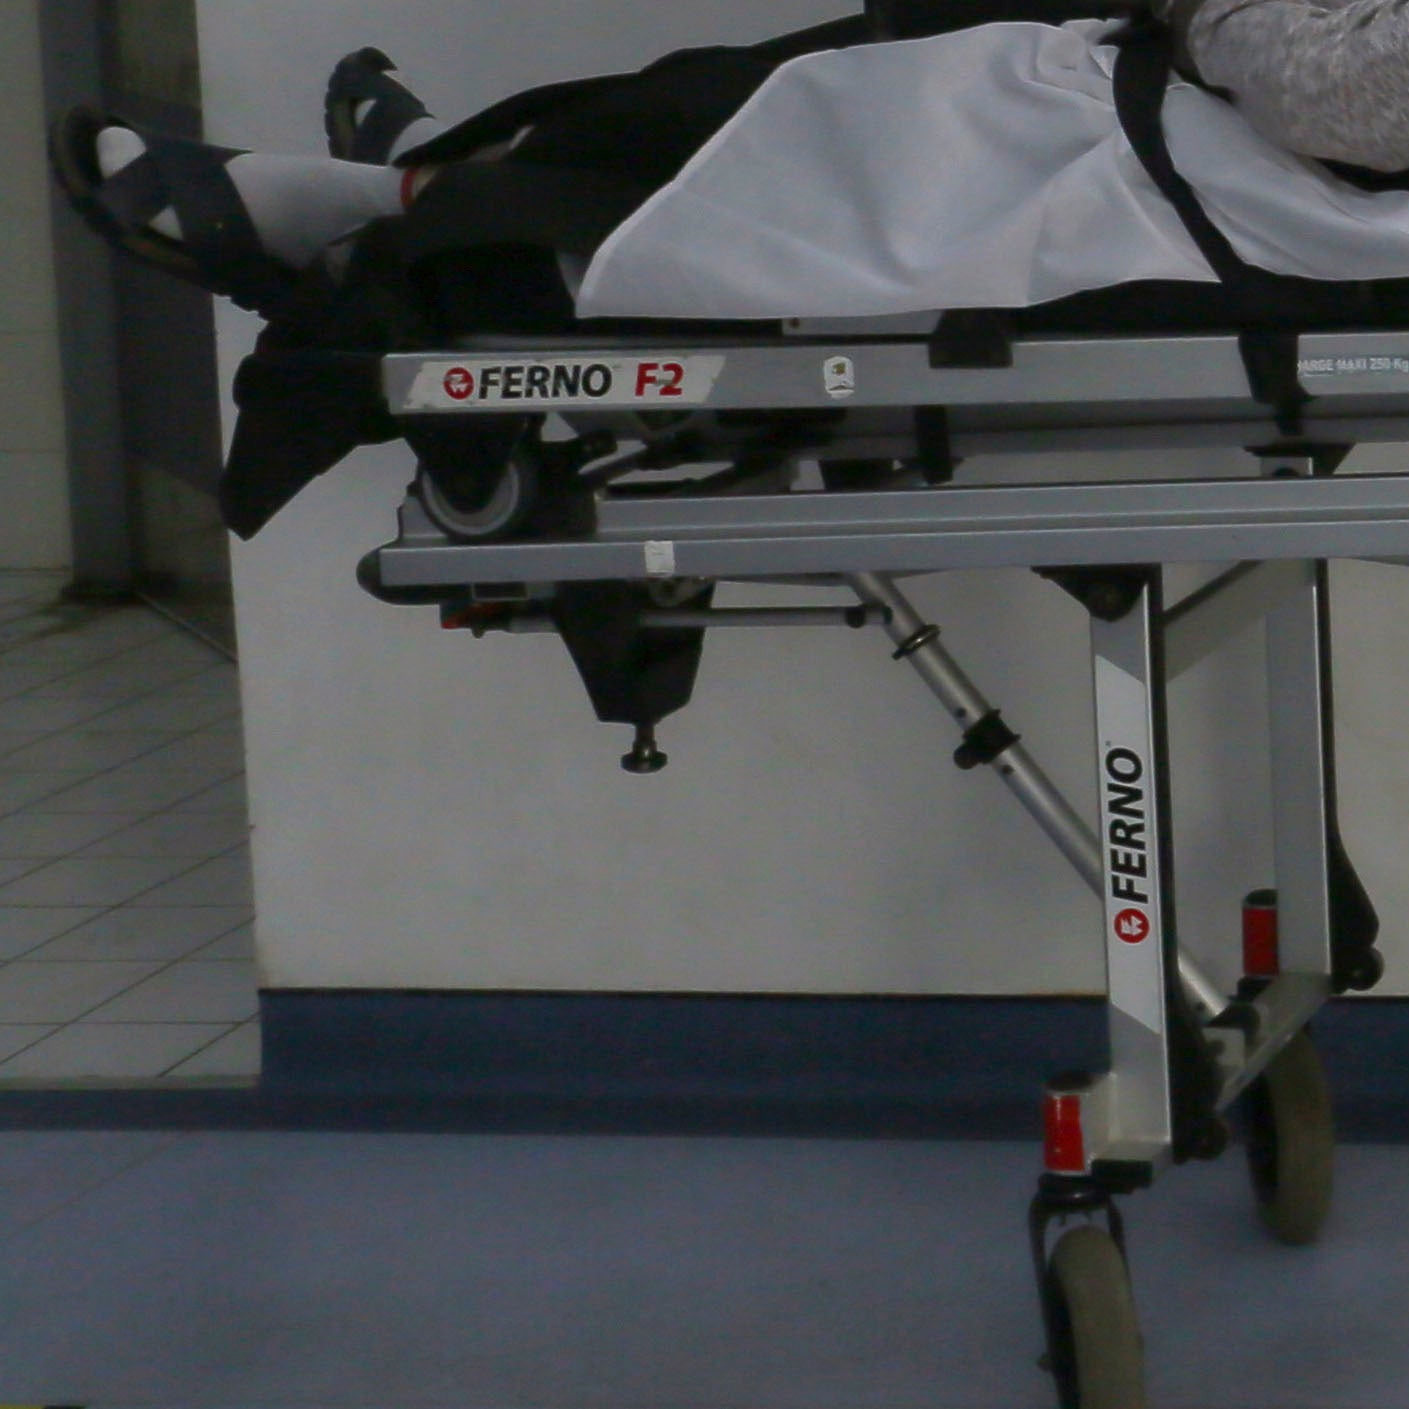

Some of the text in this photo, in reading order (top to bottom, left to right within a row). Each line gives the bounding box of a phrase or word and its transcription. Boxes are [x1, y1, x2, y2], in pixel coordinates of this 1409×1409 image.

[478, 363, 684, 399] FERNO F2
[1105, 747, 1148, 904] FERNO
